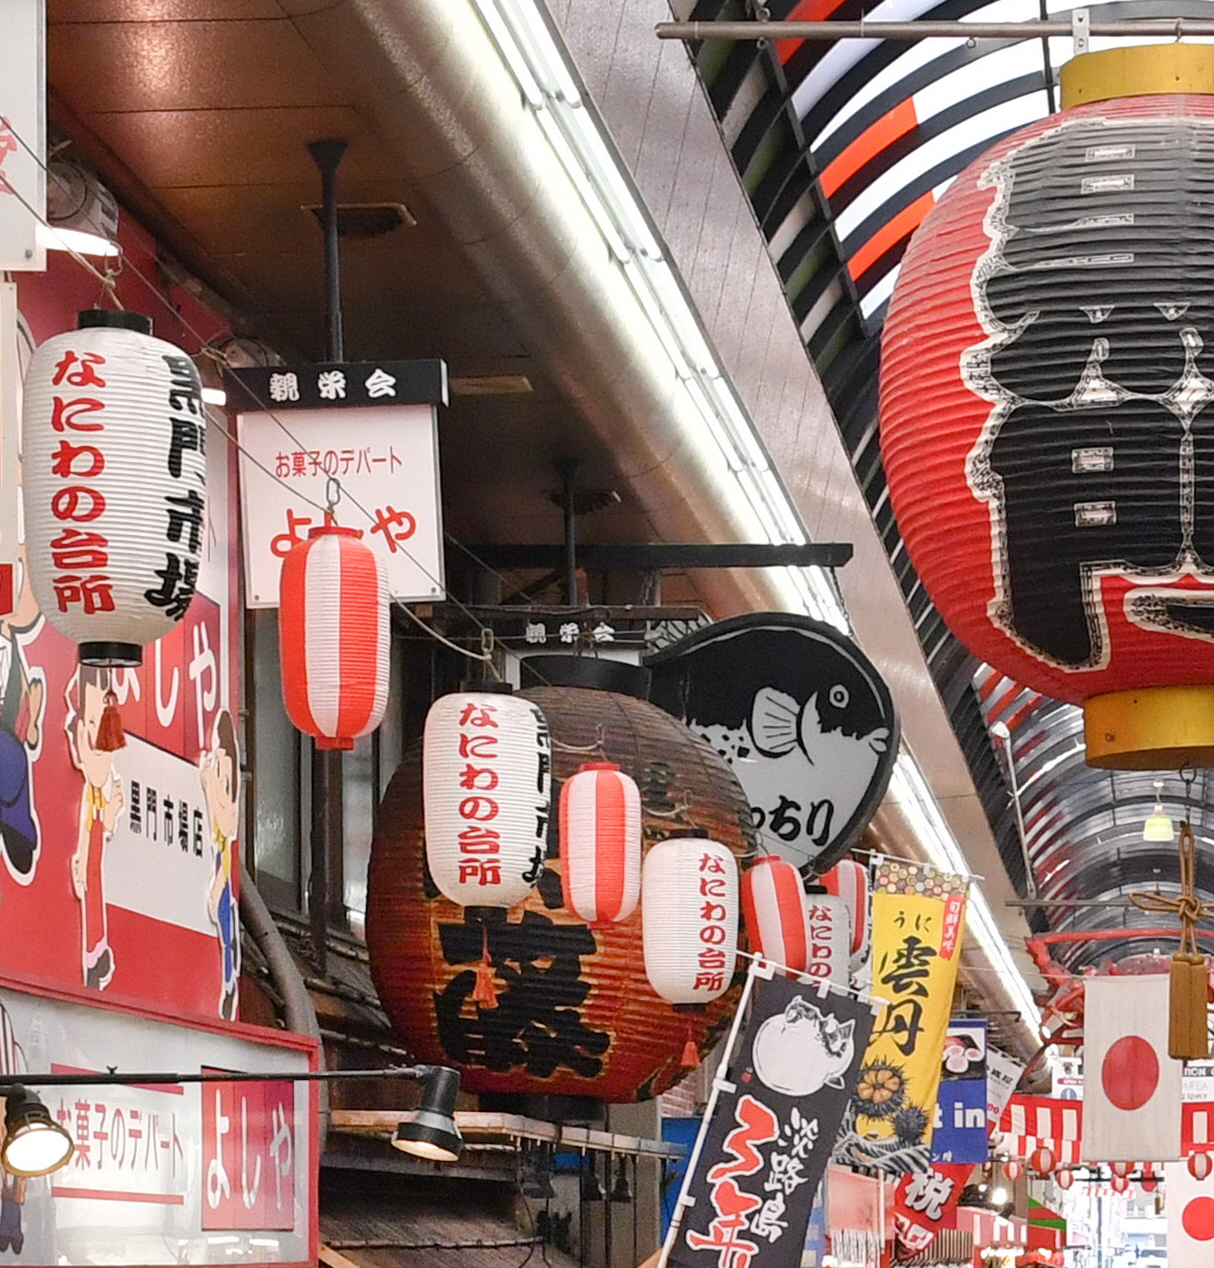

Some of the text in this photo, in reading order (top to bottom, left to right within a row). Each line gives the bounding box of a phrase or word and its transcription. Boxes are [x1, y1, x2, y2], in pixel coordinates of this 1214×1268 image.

[269, 368, 396, 401] 親栄会
[50, 350, 116, 615] なにわの台所
[275, 446, 402, 478] お菓子のデパート
[270, 505, 416, 559] よや
[457, 703, 502, 886] なにわの台所
[693, 852, 728, 992] なにわの台所
[808, 904, 834, 988] なにわの
[893, 910, 932, 932] うに
[868, 935, 938, 1057] 雲丹
[207, 1088, 292, 1210] よしや
[954, 1102, 985, 1128] in
[750, 1106, 821, 1244] 淡路島
[905, 1167, 955, 1221] 税
